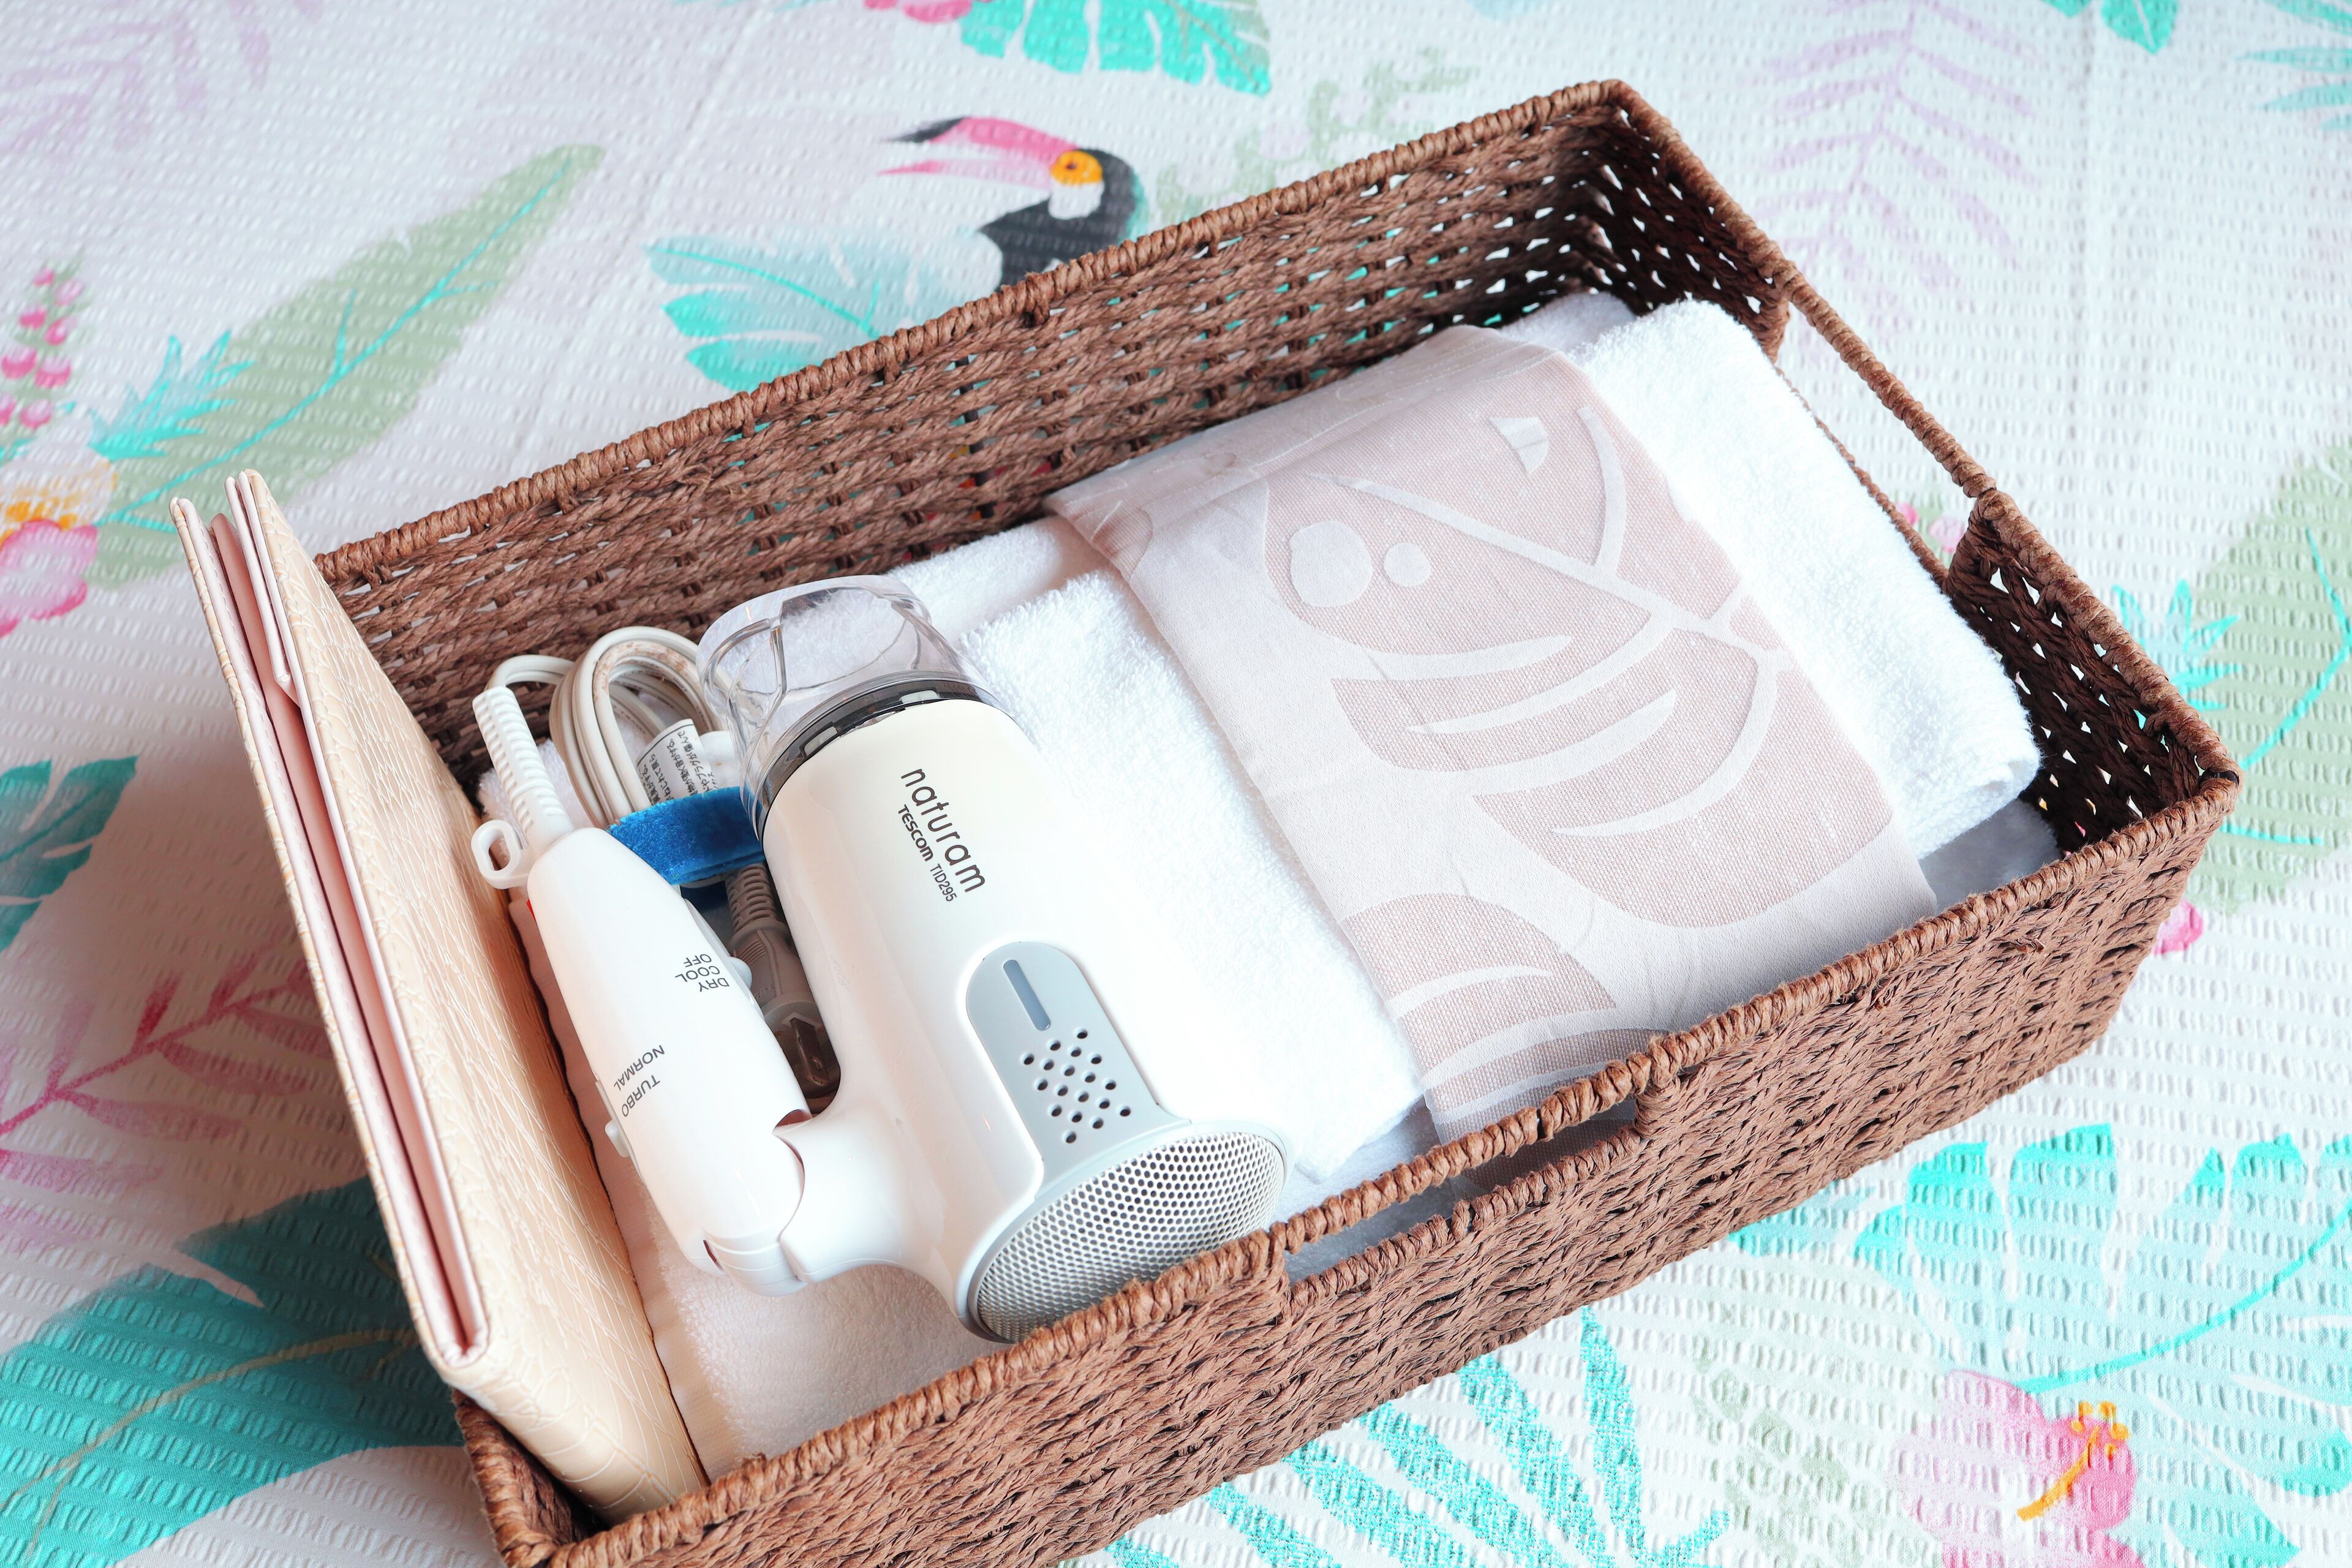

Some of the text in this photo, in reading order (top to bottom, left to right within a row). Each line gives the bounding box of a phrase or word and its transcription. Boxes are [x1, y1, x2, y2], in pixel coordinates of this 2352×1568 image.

[900, 768, 986, 892] naturam
[930, 863, 957, 902] TID295
[675, 965, 720, 982] COOL
[684, 954, 712, 968] OFF
[698, 978, 729, 992] DRY
[614, 1045, 665, 1091] NORMAL
[621, 1074, 660, 1117] TURBO
